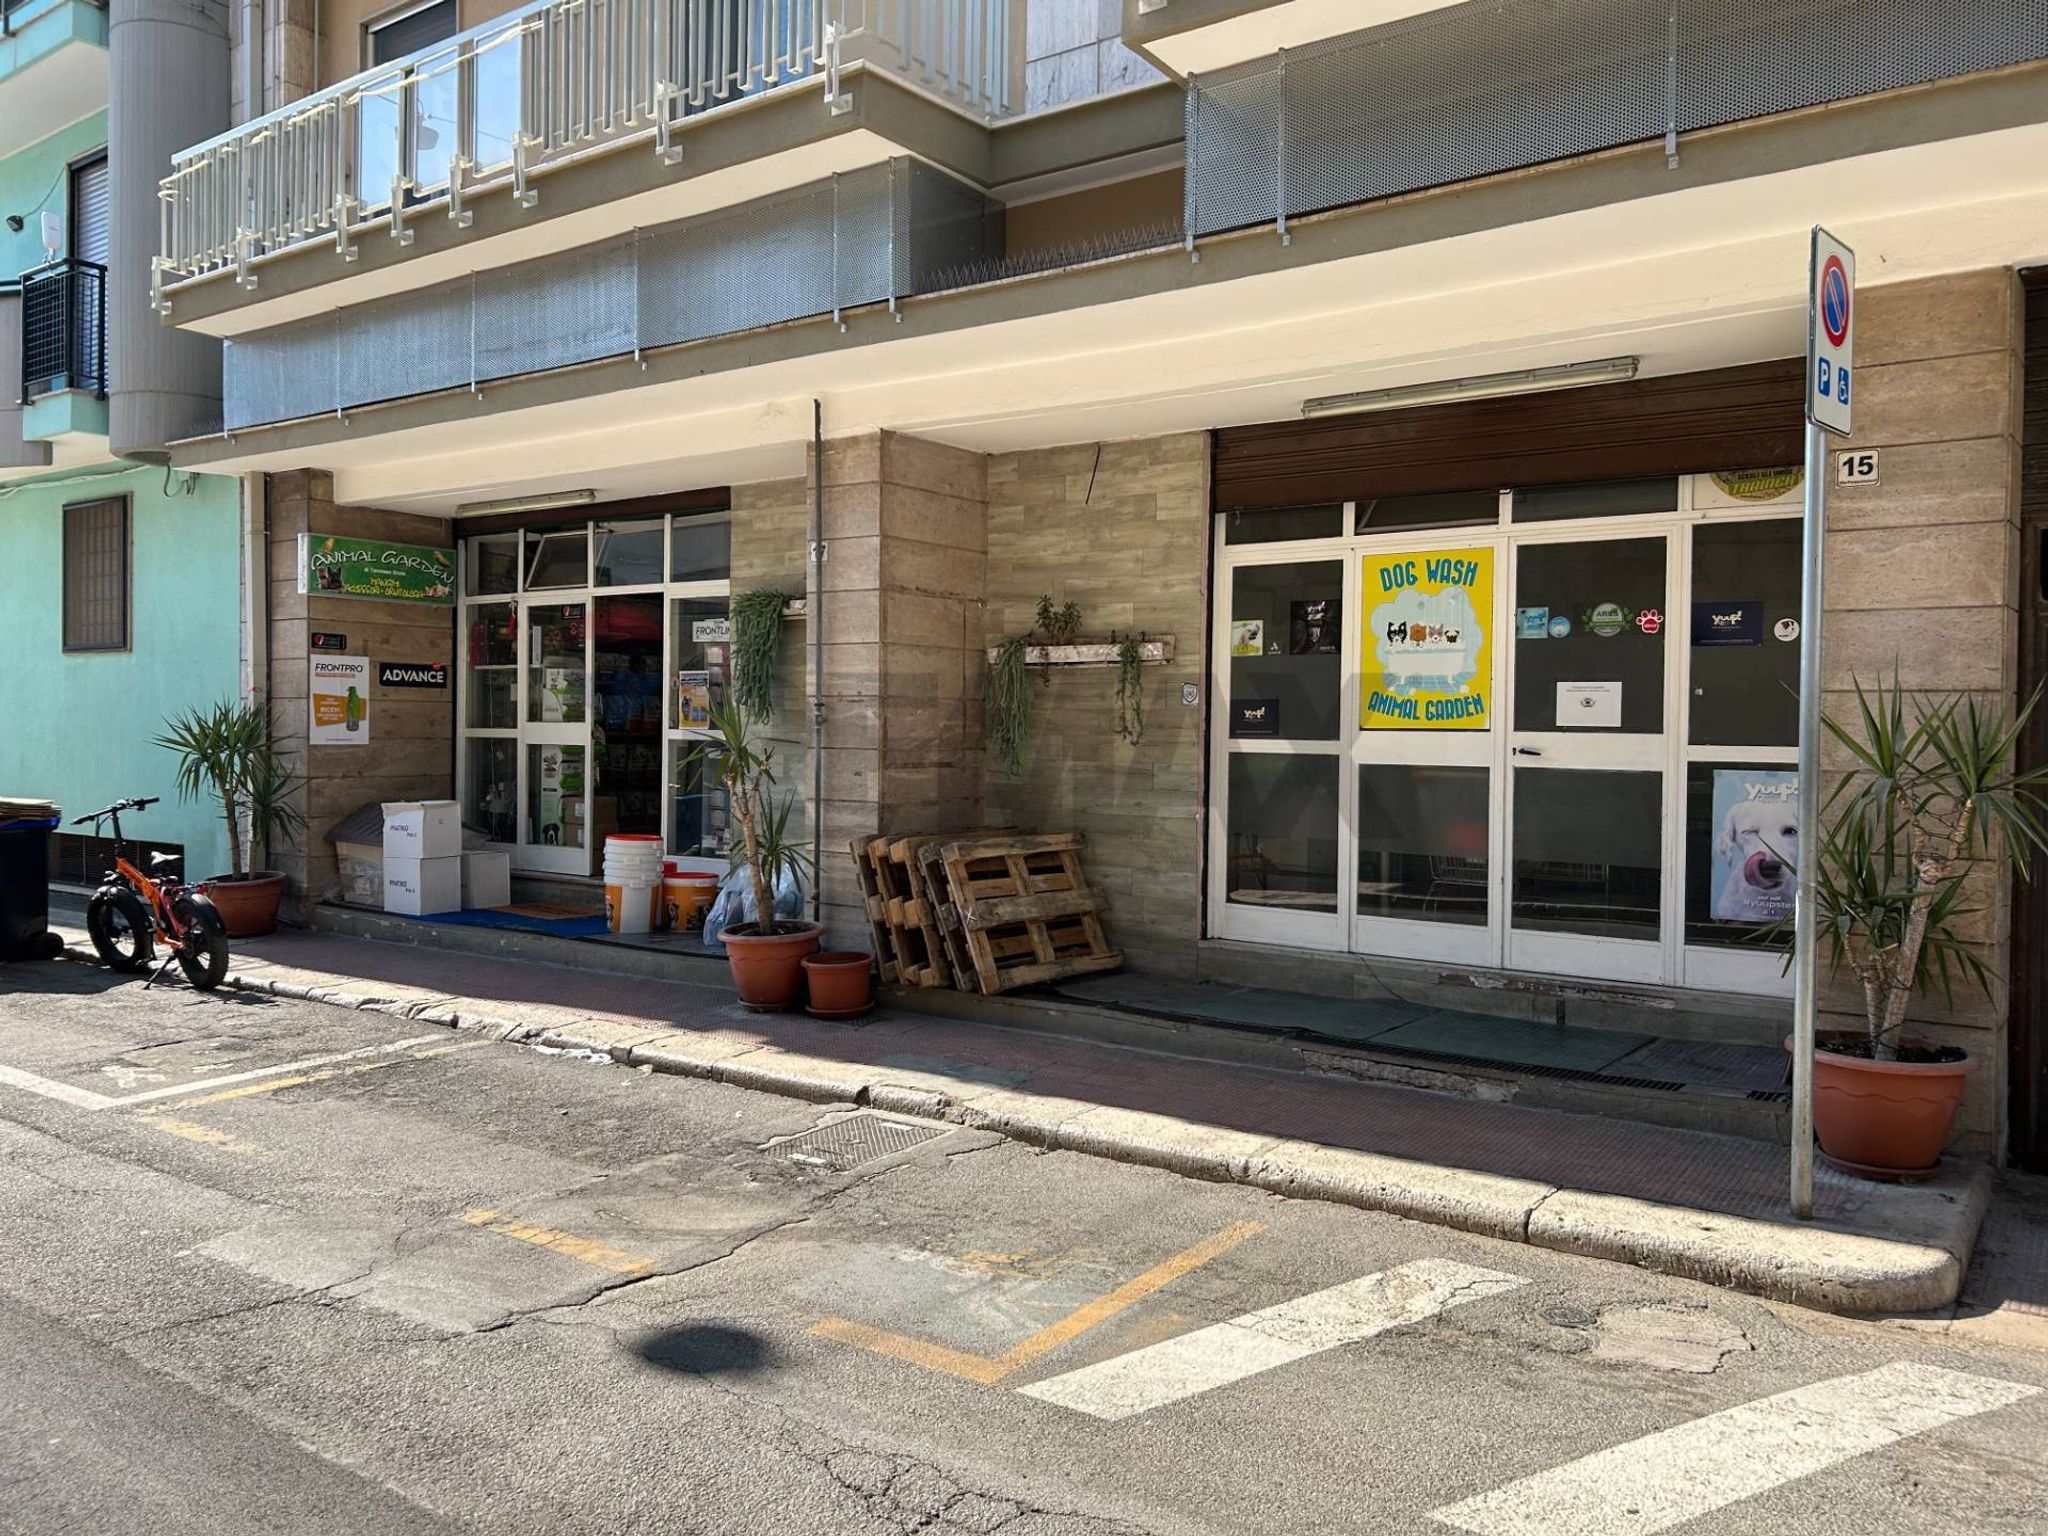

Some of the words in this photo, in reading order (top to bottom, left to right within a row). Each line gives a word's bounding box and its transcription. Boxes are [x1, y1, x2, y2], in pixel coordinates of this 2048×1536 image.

[1820, 361, 1829, 392] P
[1842, 455, 1874, 476] 15
[311, 550, 377, 570] ANIMAL
[381, 550, 455, 583] GARDEN
[1379, 560, 1418, 592] DOG
[1425, 558, 1479, 588] WASH
[315, 662, 363, 673] FRONTPRO
[382, 669, 444, 683] ADVANCE
[1367, 691, 1420, 720] ANIMAL
[1425, 693, 1485, 721] GARDEN
